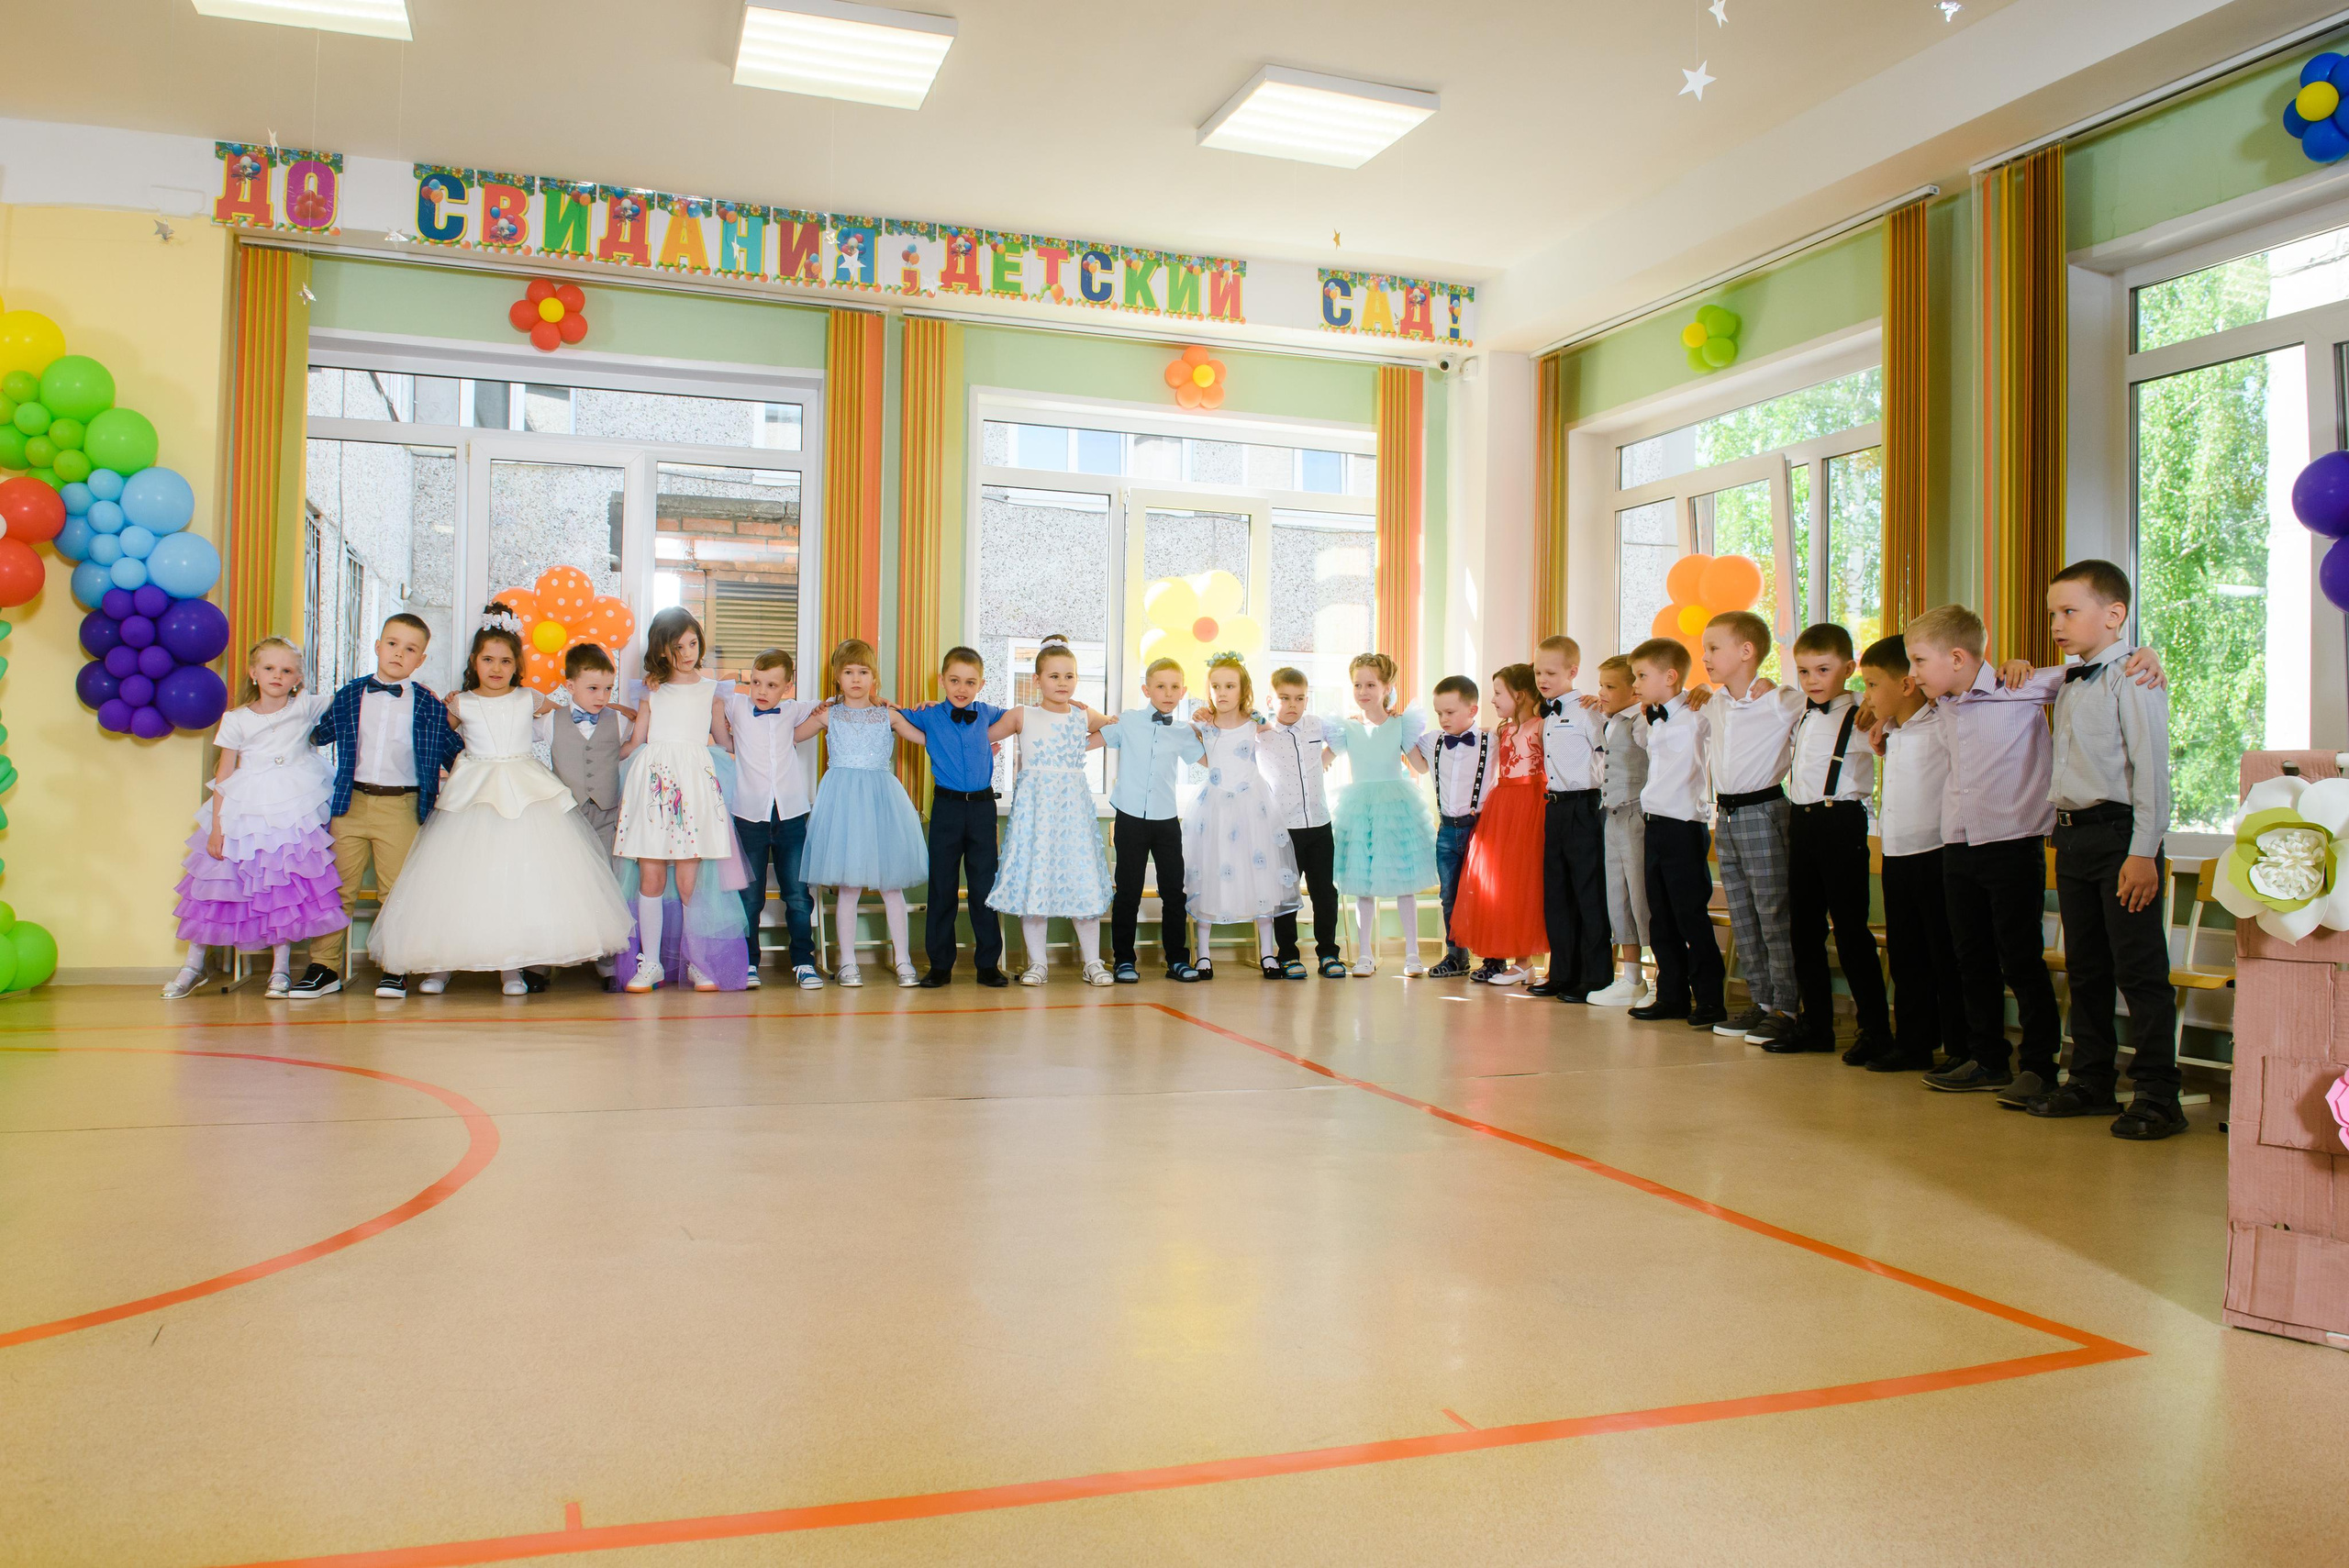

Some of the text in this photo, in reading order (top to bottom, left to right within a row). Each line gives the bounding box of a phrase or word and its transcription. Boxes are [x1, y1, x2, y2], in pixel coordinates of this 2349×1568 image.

[212, 152, 340, 231] ДО
[938, 233, 1244, 320] ДЕТСКИЙ
[1320, 276, 1464, 340] САД!
